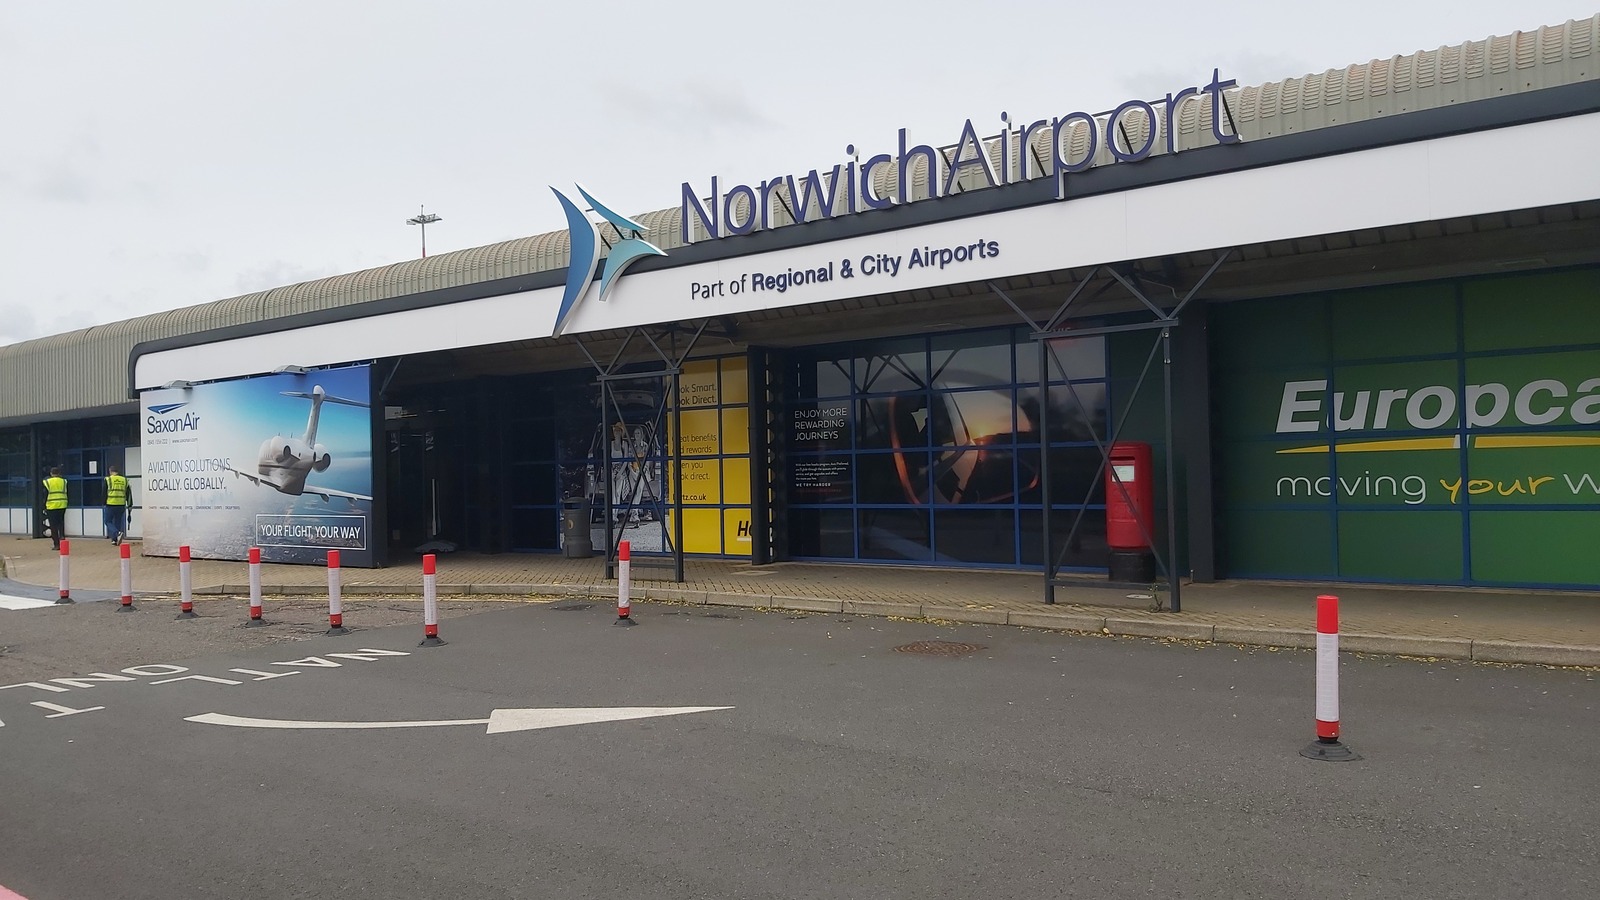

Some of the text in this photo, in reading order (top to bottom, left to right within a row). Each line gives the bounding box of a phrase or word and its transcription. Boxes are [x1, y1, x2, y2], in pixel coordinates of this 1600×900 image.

[691, 238, 1000, 300] Part of Regional & City Airports
[691, 383, 717, 393] Smart.
[692, 395, 717, 405] Direct.
[795, 408, 847, 419] ENJOY MORE
[1276, 377, 1600, 449] Europca
[147, 412, 200, 434] SaxonAir
[795, 419, 845, 430] REWARDING
[691, 433, 717, 442] benefits
[795, 431, 839, 441] JOURNEYS
[686, 445, 712, 454] rewards
[148, 458, 231, 474] AVIATION SOLUTIONS
[691, 462, 704, 470] you
[690, 472, 710, 480] direct.
[148, 477, 226, 492] LOCALLY. GLOBALLY.
[1440, 475, 1555, 504] your
[261, 524, 361, 539] YOUR FLIGHT, YOUR WAY
